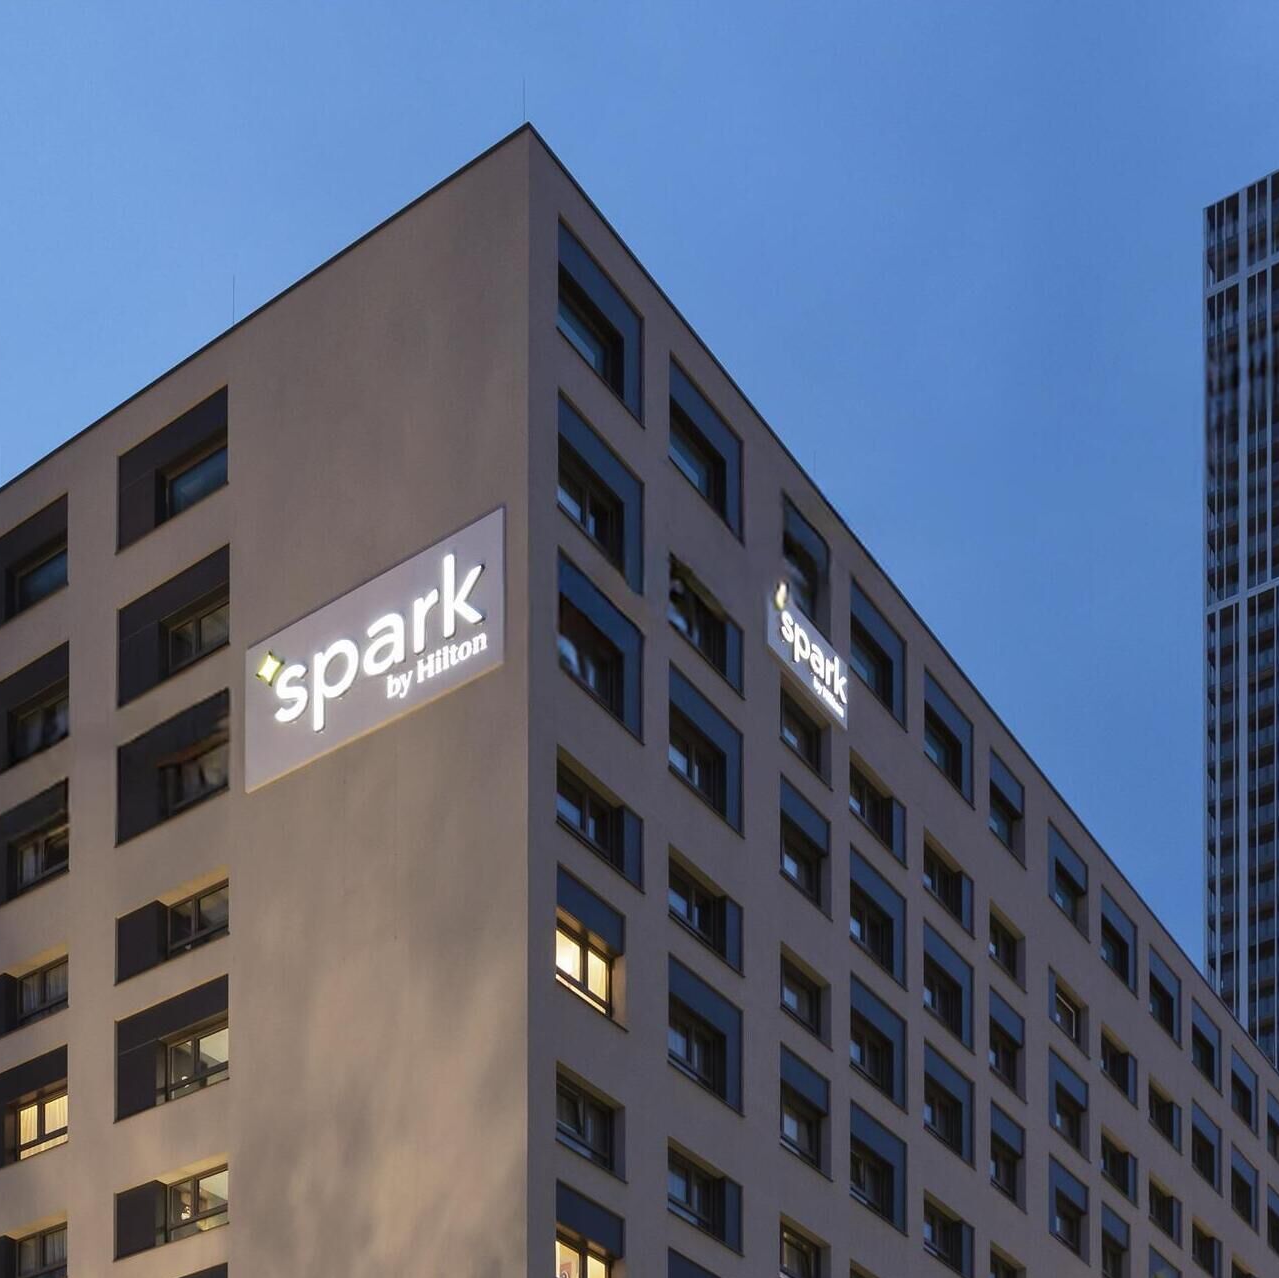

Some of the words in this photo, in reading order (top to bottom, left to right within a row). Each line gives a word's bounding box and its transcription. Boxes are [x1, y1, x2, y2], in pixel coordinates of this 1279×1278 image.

[273, 552, 486, 733] spark
[386, 667, 415, 699] by
[416, 631, 488, 684] Hilton
[780, 610, 848, 705] spark
